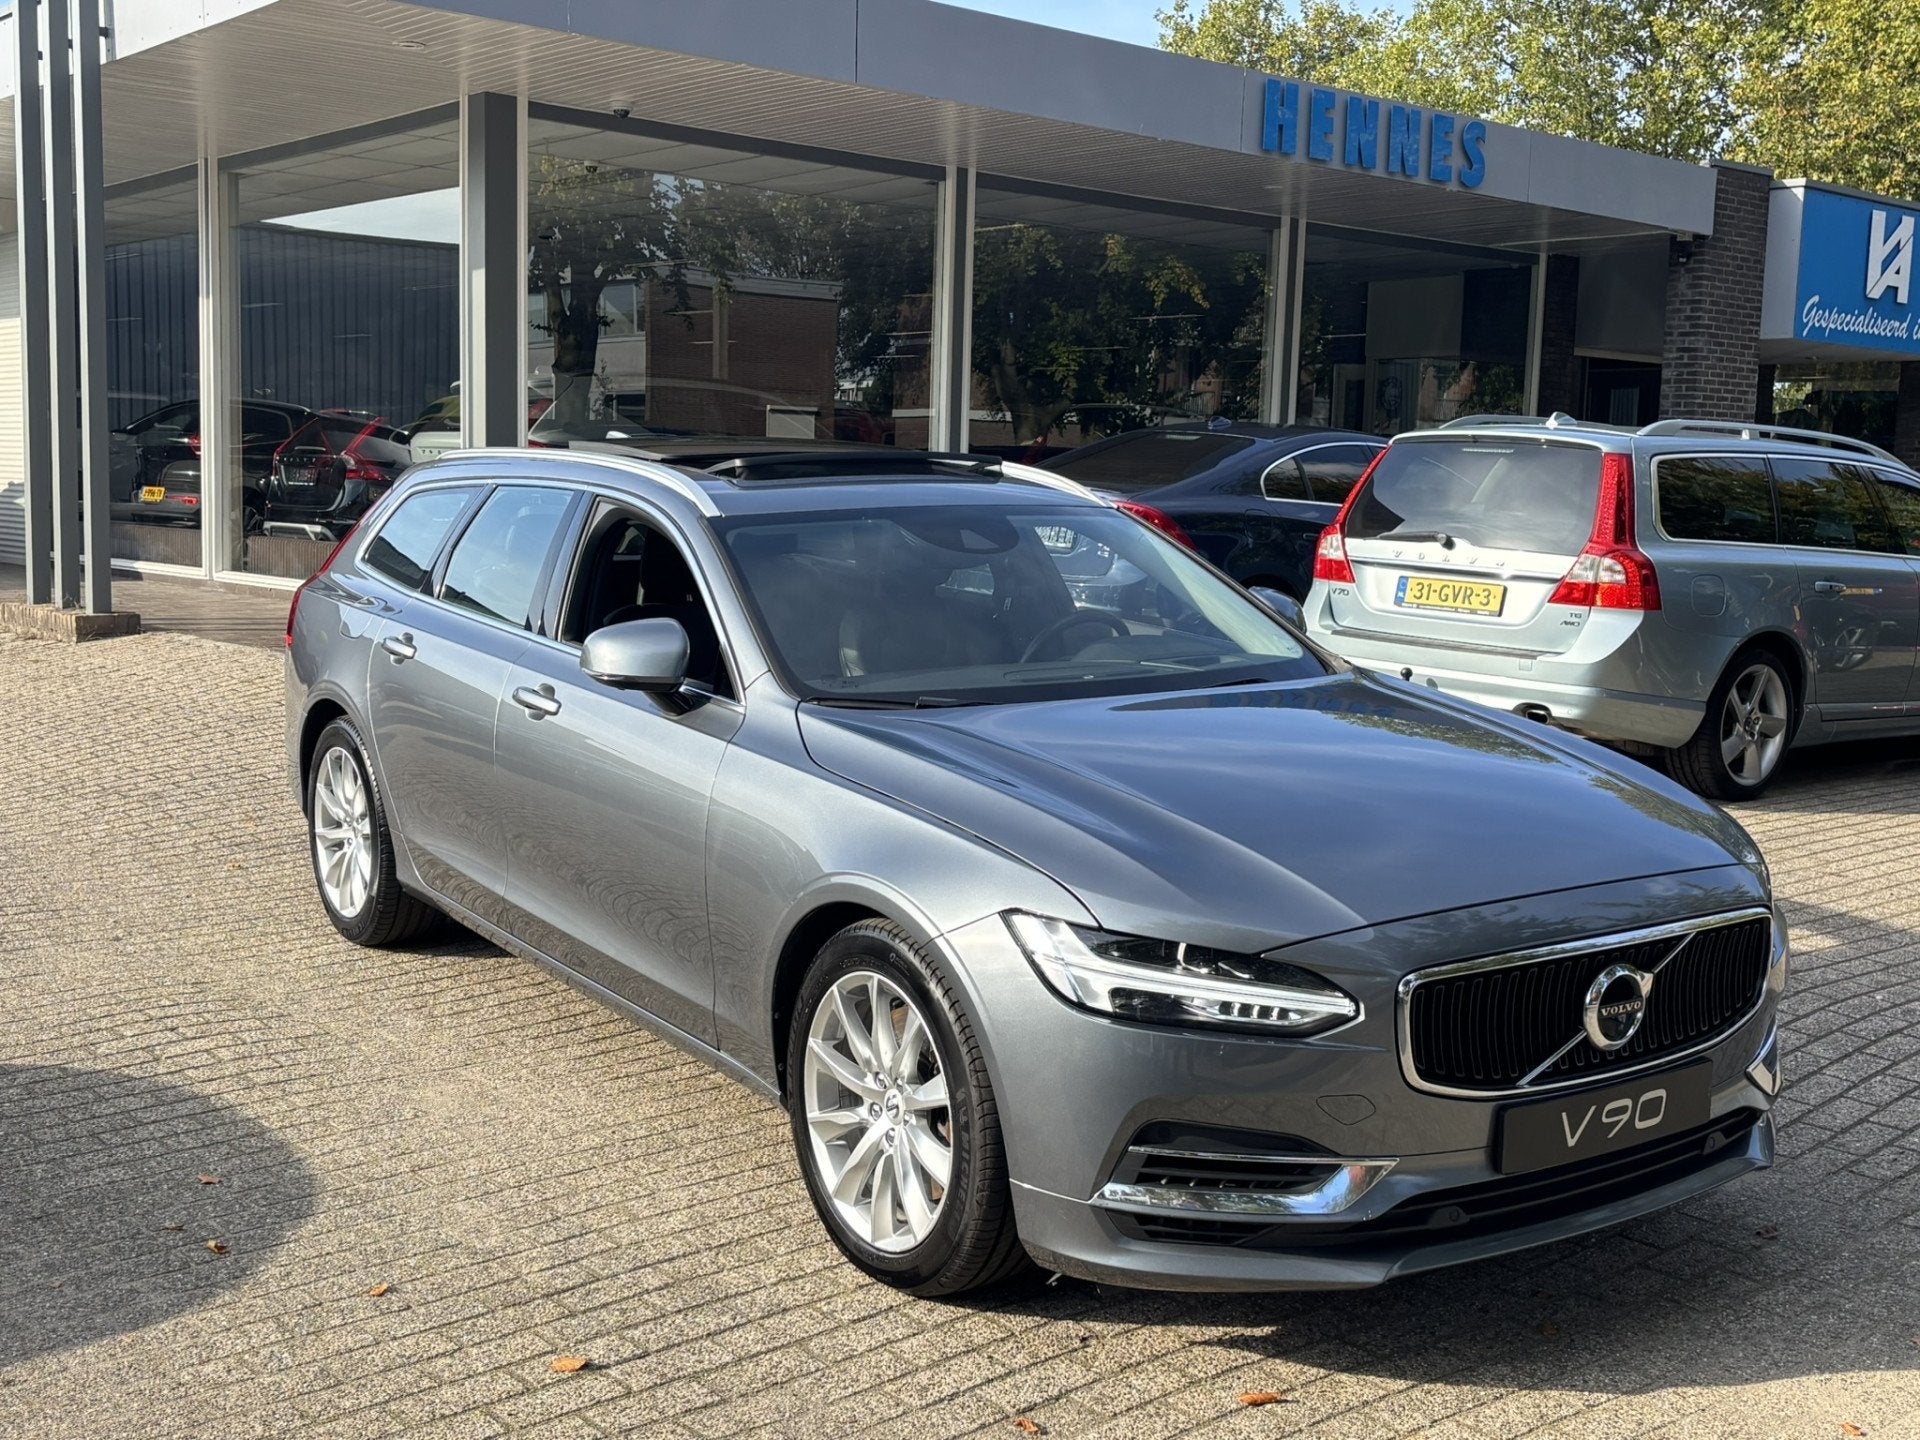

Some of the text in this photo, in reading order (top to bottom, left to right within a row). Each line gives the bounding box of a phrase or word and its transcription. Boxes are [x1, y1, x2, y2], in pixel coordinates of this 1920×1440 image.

[1263, 78, 1487, 188] HENNES
[1802, 294, 1912, 340] Gespecialiseerd
[1332, 588, 1350, 596] V70
[1413, 582, 1492, 607] 31-GVR-3
[1601, 1001, 1642, 1016] VOLVO
[1561, 1088, 1667, 1148] V90
